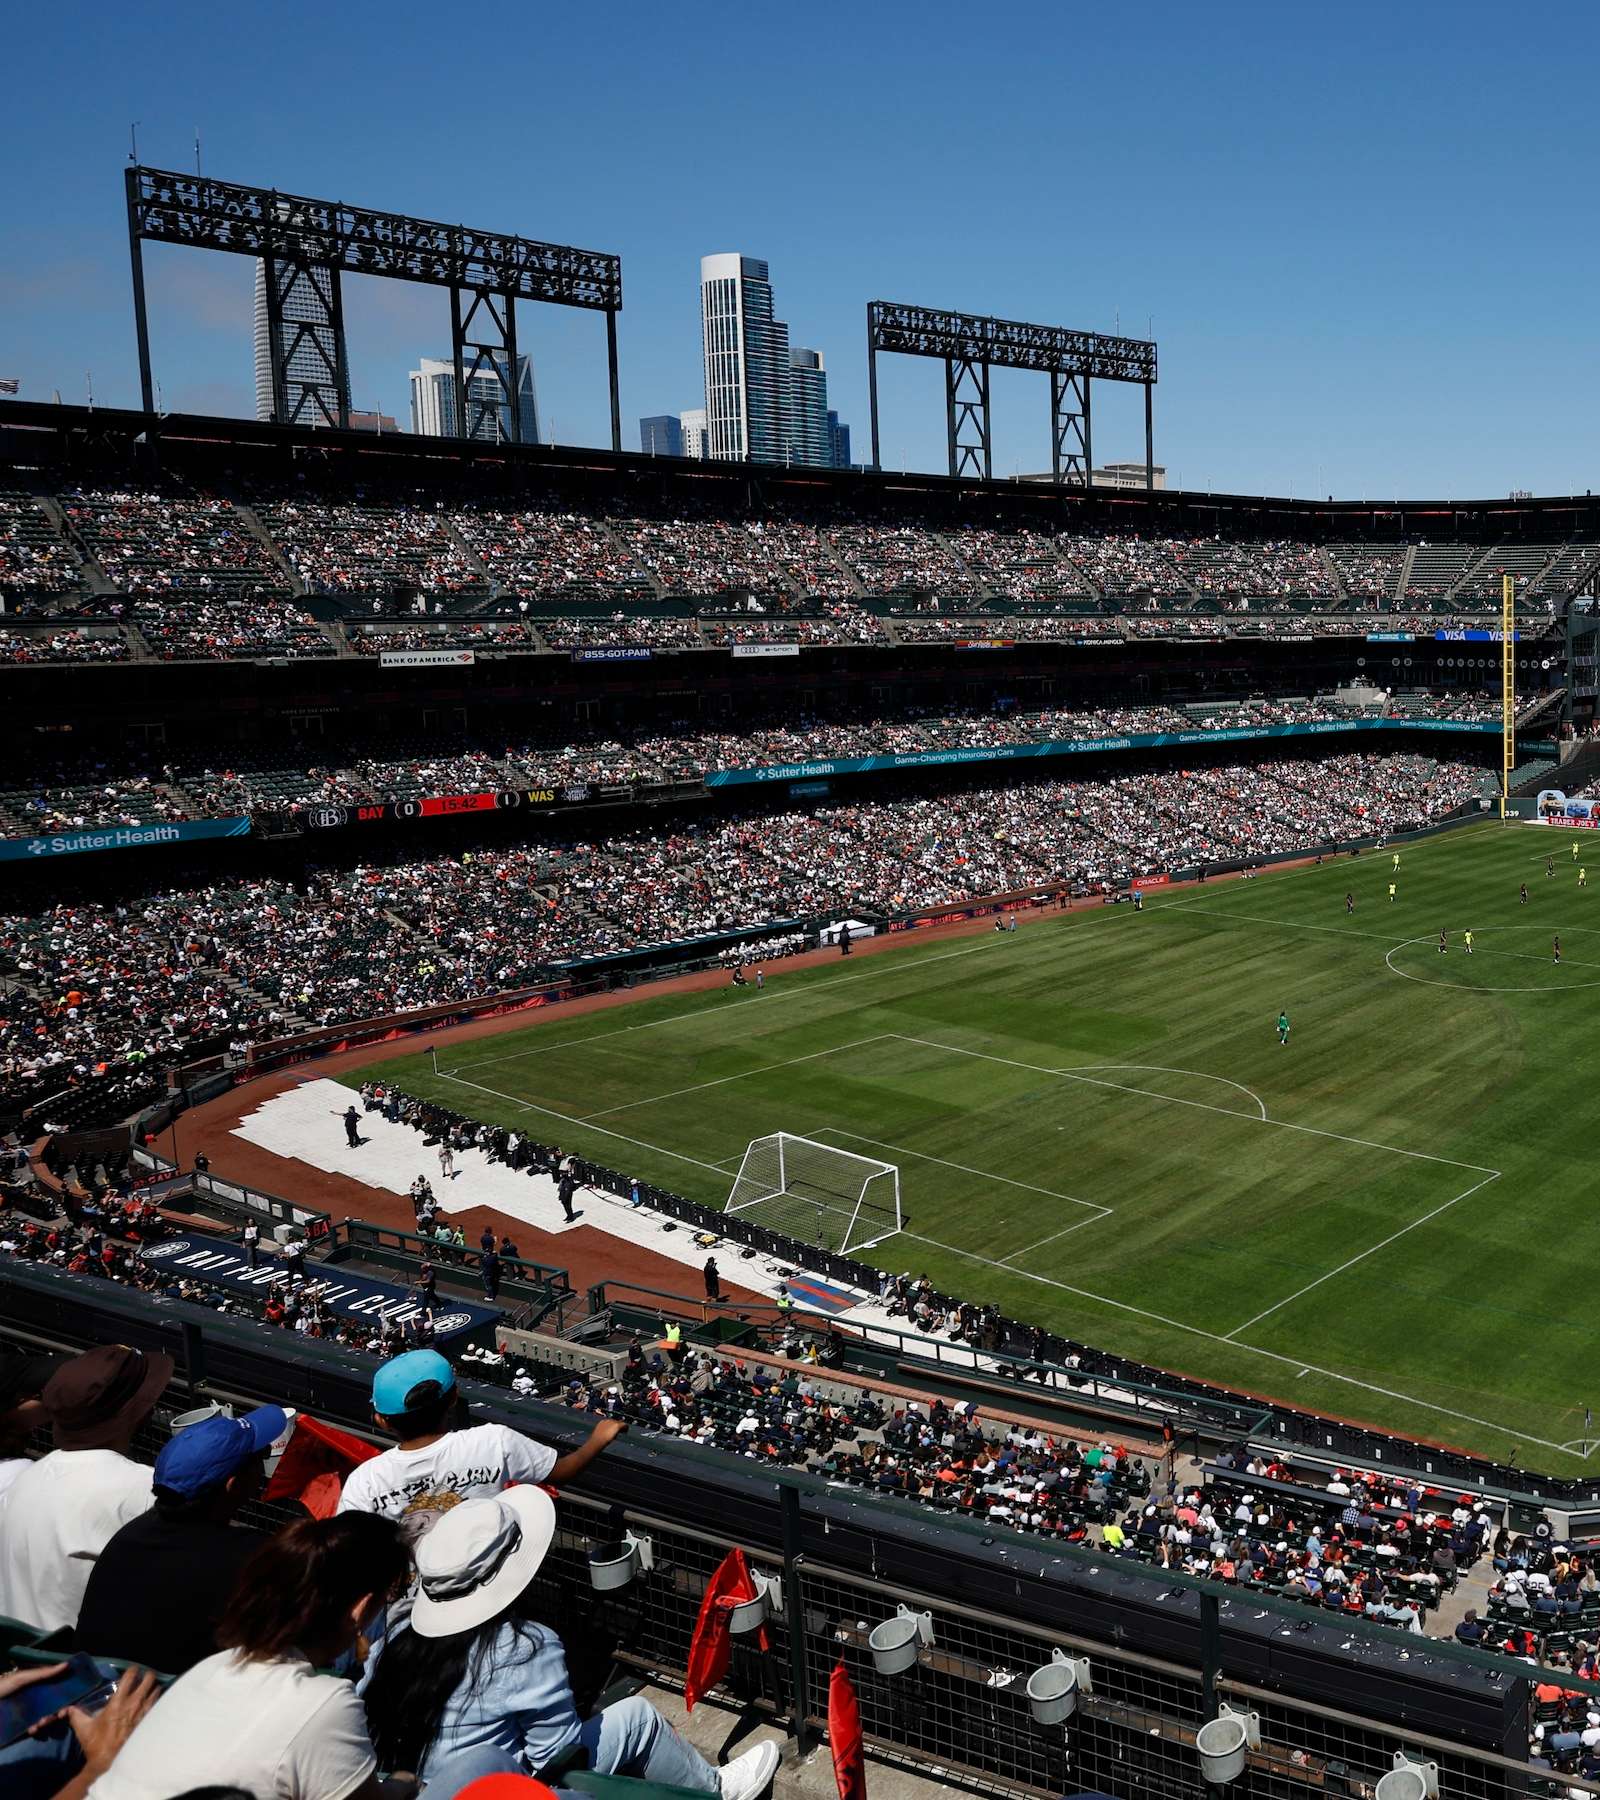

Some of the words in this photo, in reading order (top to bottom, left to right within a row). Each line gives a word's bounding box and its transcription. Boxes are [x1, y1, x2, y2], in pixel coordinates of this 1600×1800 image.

[1442, 630, 1466, 640] VISA
[418, 656, 455, 664] AMERICA
[1315, 723, 1336, 732] Sutter
[1336, 721, 1357, 730] Health
[1179, 732, 1226, 743] Game-Changing
[1227, 729, 1255, 740] Neurology
[1255, 728, 1269, 736] Care
[1077, 741, 1104, 751] Sutter
[1104, 738, 1131, 749] Health
[894, 753, 957, 765] Game-Changing
[957, 749, 996, 761] Neurology
[997, 748, 1015, 757] Care
[767, 767, 799, 779] Sutter
[801, 763, 835, 775] Health
[527, 790, 555, 803] WAS
[403, 803, 414, 816] 0
[441, 797, 478, 811] 15:42
[357, 805, 385, 821] BAY
[1550, 817, 1576, 827] TRADER
[1578, 819, 1595, 828] JOE'S
[51, 835, 113, 853] Sutter
[116, 826, 180, 845] Health
[1136, 877, 1164, 887] ORACLE
[174, 1250, 242, 1271] BAY
